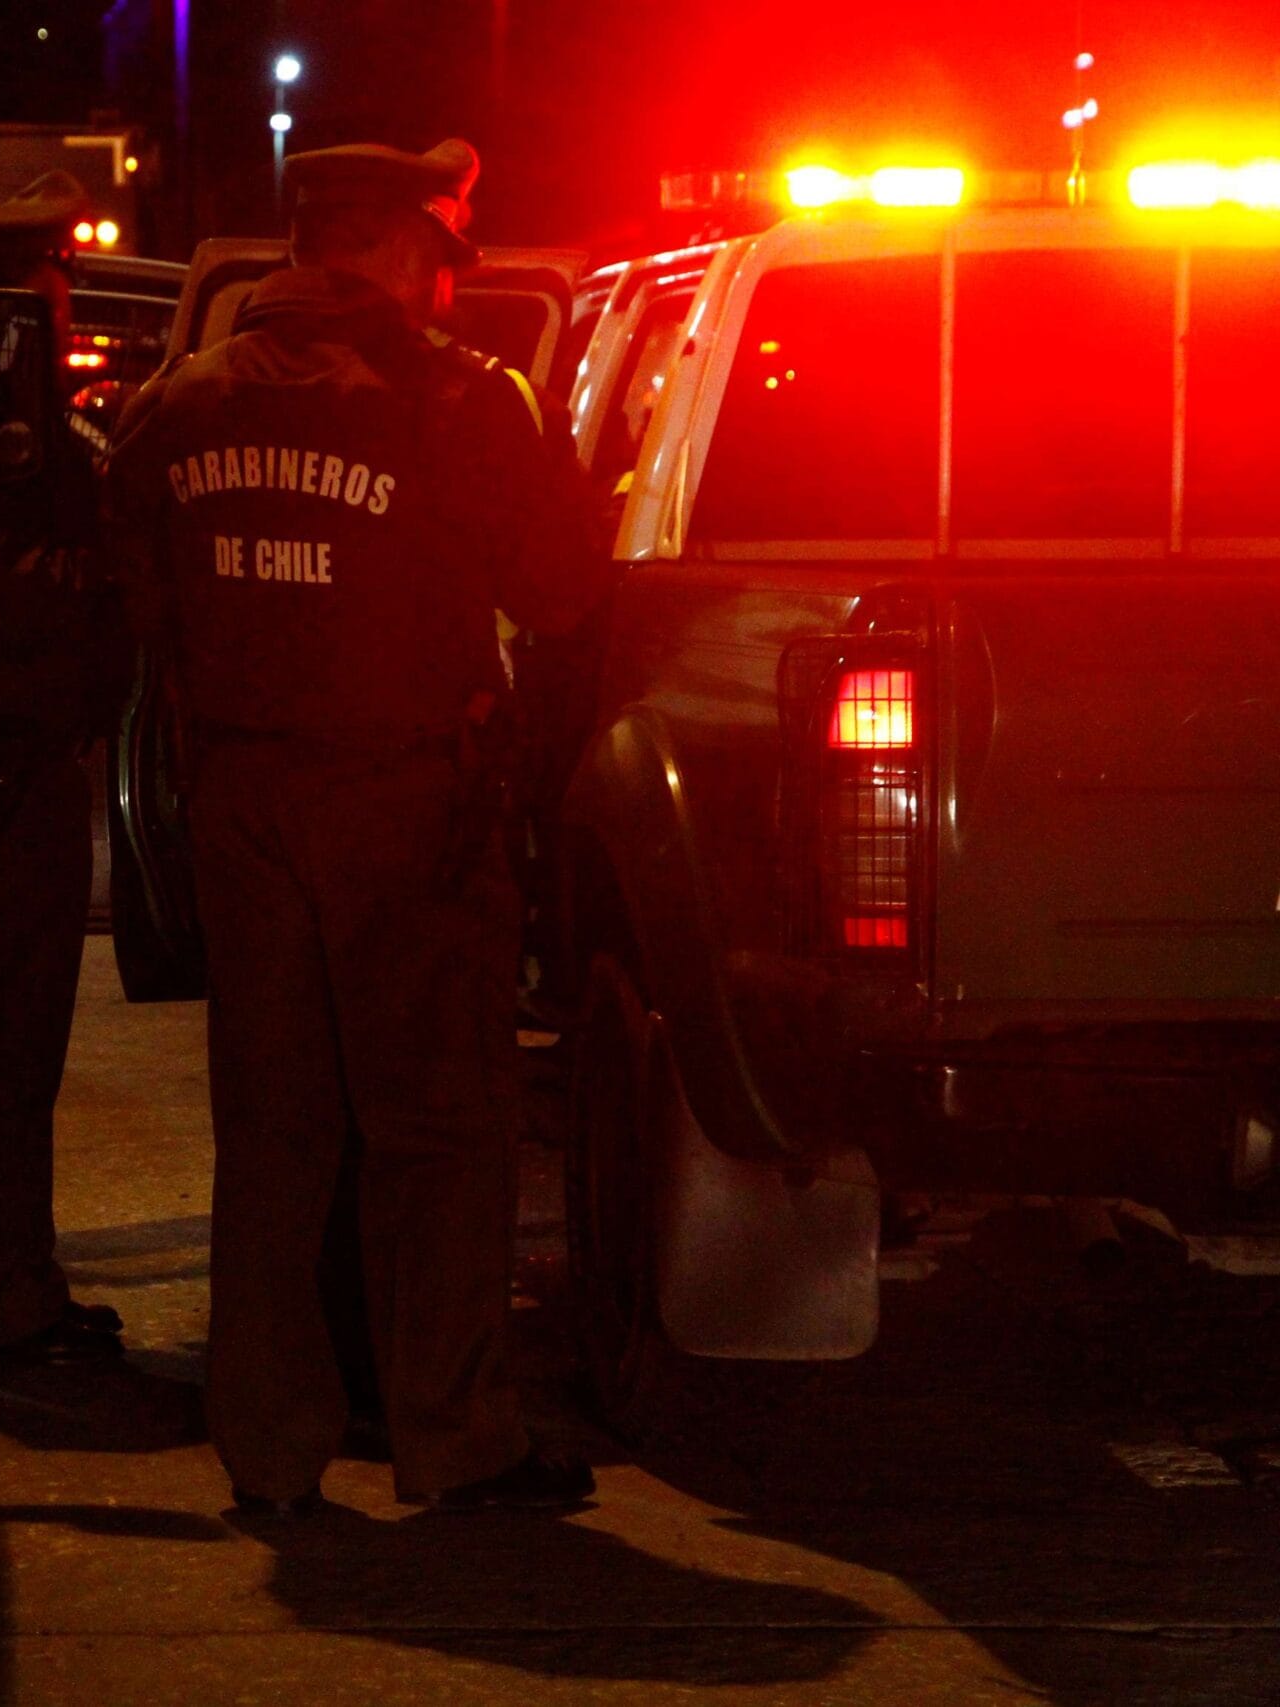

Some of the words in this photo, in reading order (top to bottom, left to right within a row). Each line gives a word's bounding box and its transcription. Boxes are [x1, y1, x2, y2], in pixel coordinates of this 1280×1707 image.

[169, 446, 396, 516] CARABINEROS
[215, 535, 245, 578] DE
[255, 538, 333, 585] CHILE
